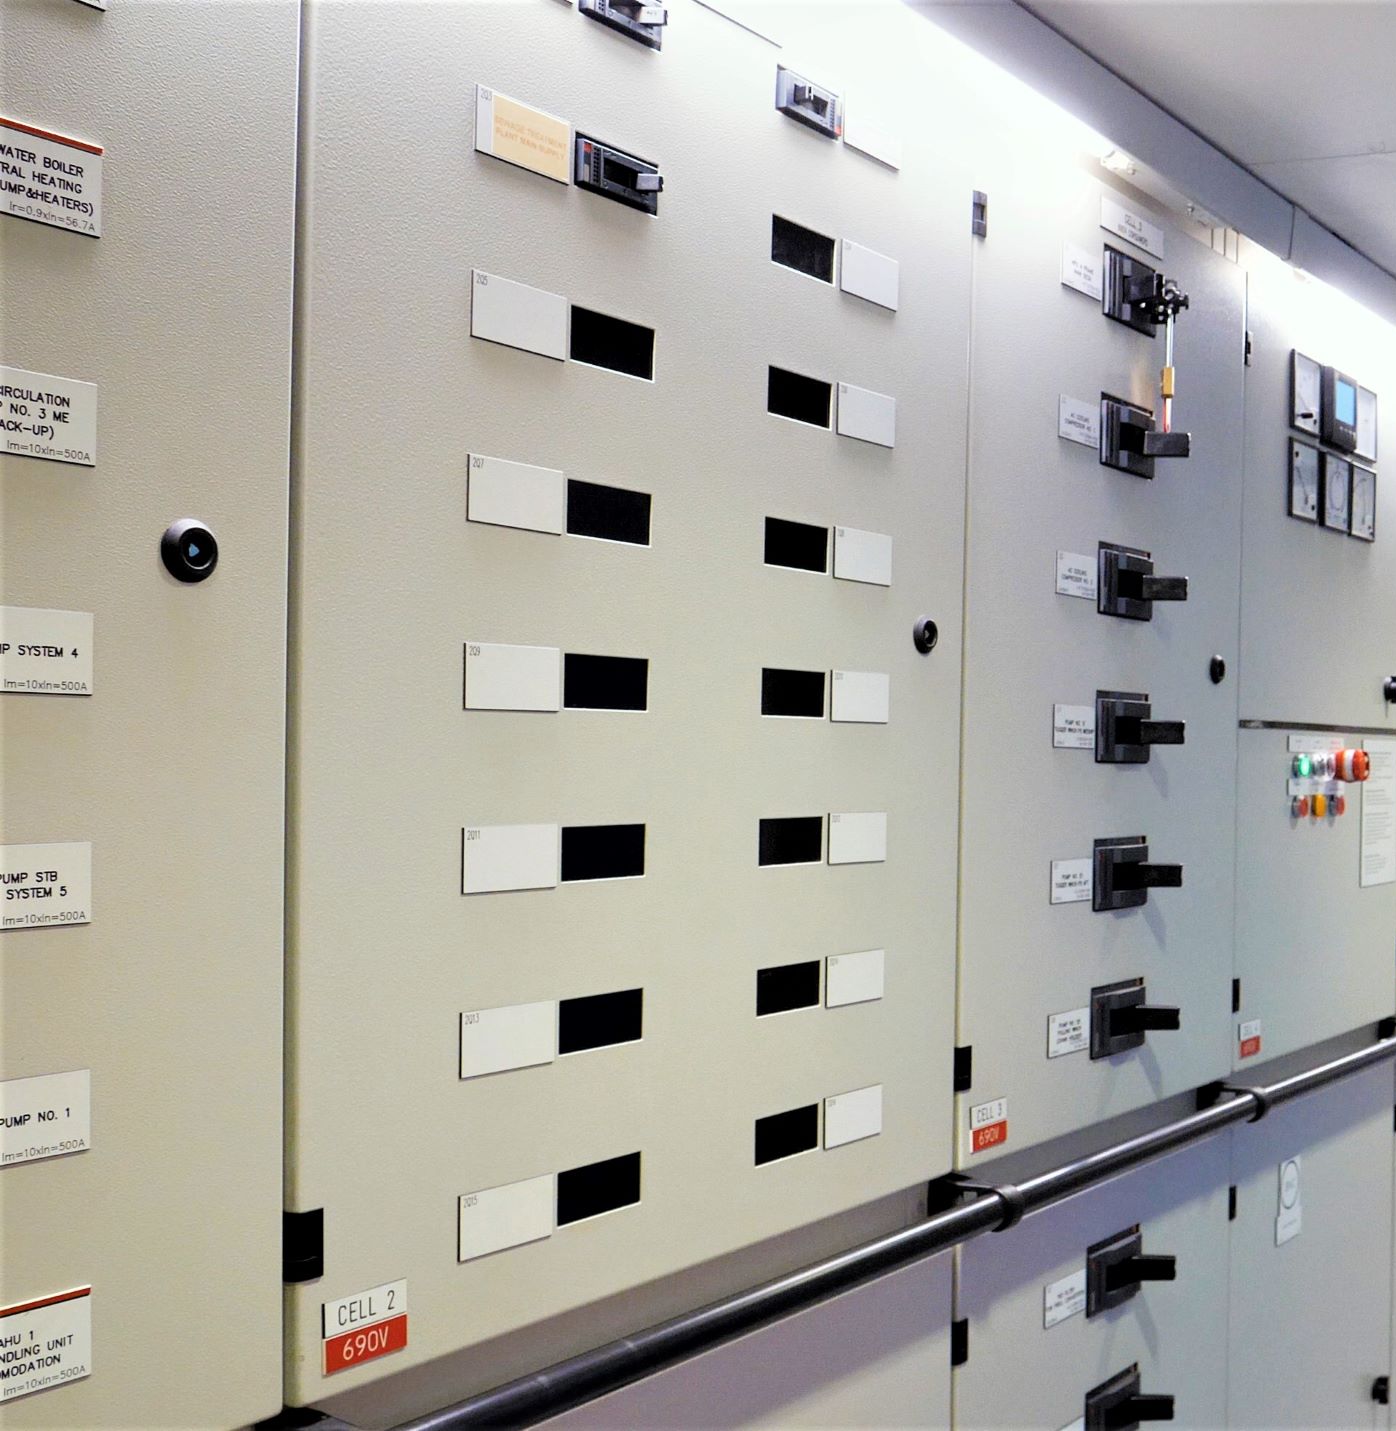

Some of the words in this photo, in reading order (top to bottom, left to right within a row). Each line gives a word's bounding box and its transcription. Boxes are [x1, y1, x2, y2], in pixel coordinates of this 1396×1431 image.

[43, 156, 84, 178] BOILER
[32, 171, 82, 194] HEATING
[0, 180, 94, 216] UMP&HEATERS)
[0, 385, 70, 408] IRCULATION
[10, 404, 31, 417] NO.
[39, 408, 47, 419] 3
[53, 411, 70, 423] ME
[18, 645, 63, 658] SYSTEM
[71, 648, 78, 658] 4
[36, 871, 58, 882] STB
[6, 887, 52, 900] SYSTEM
[60, 886, 67, 896] 5
[38, 1110, 58, 1122] NO.
[65, 1107, 70, 1117] 1
[977, 1107, 994, 1123] CELL
[338, 1297, 376, 1326] CELL
[387, 1290, 395, 1310] 2
[29, 1330, 34, 1340] 1
[47, 1334, 73, 1351] UNIT
[343, 1326, 389, 1360] 690V
[0, 1354, 61, 1380] MODATION
